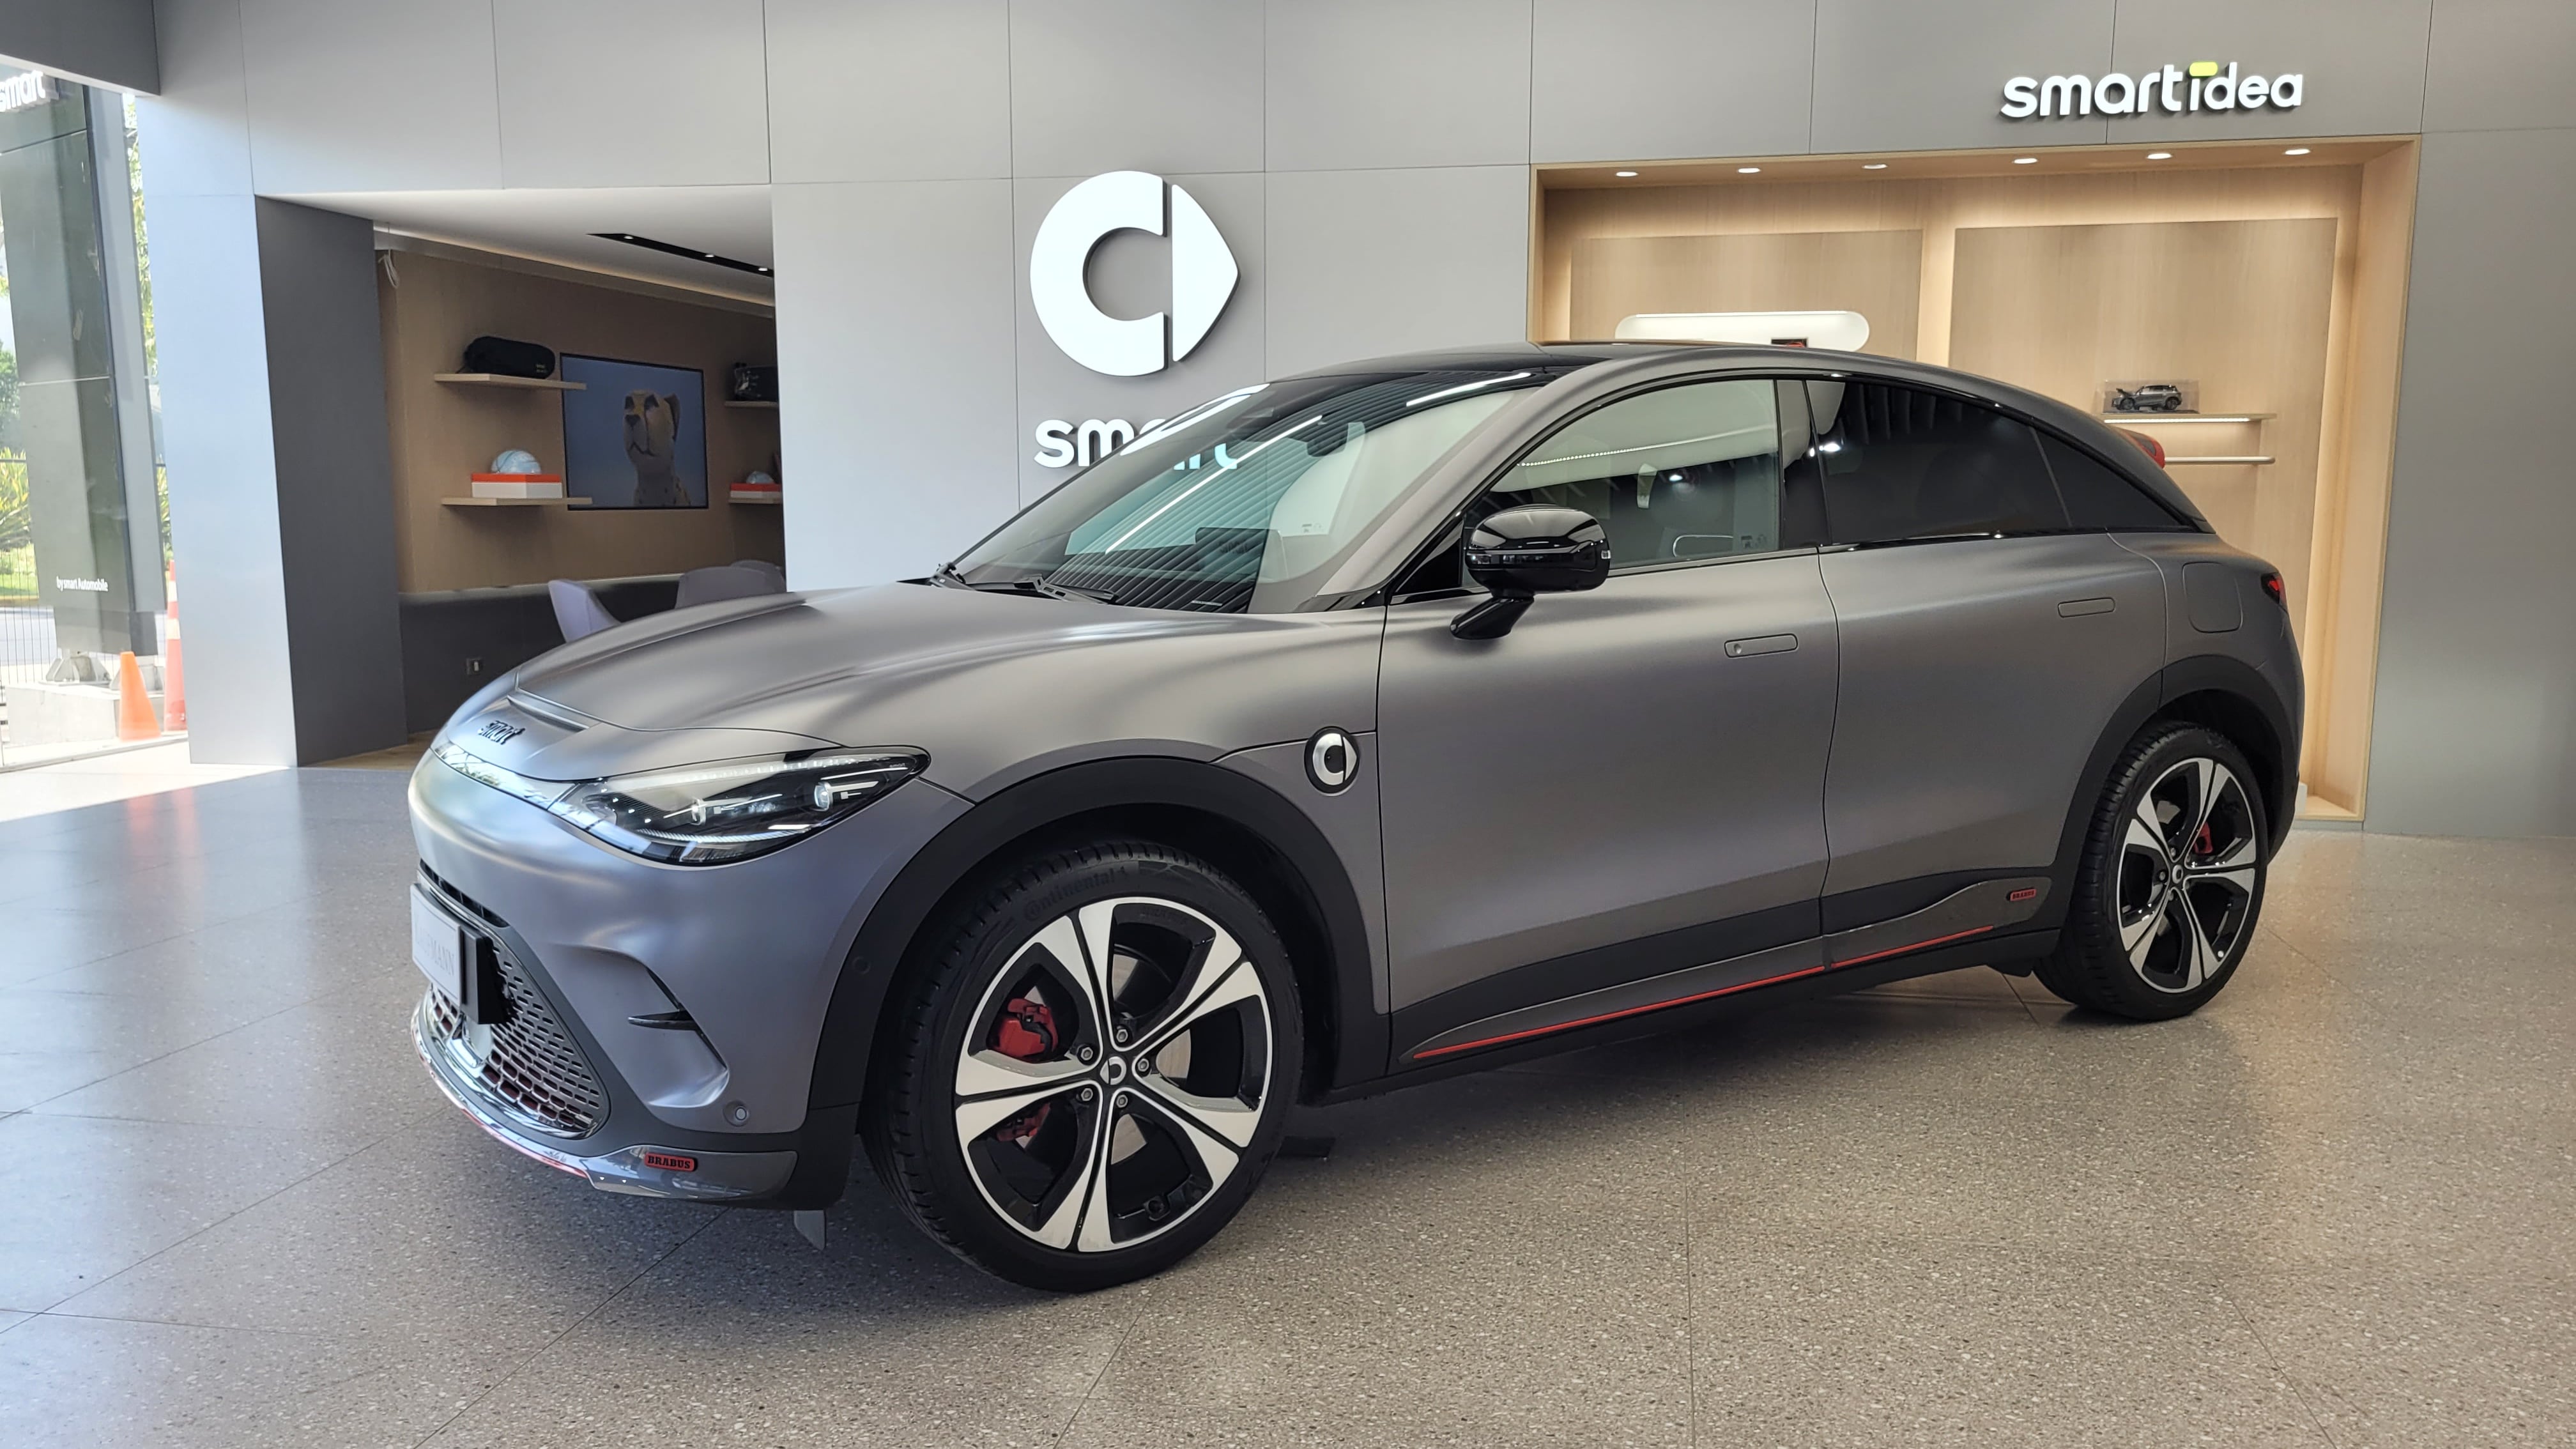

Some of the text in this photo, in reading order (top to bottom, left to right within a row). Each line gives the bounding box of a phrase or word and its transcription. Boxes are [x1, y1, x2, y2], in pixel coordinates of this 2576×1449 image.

[56, 576, 109, 592] by smart Automobile
[479, 720, 525, 745] smart
[648, 1155, 691, 1169] BRABUS
